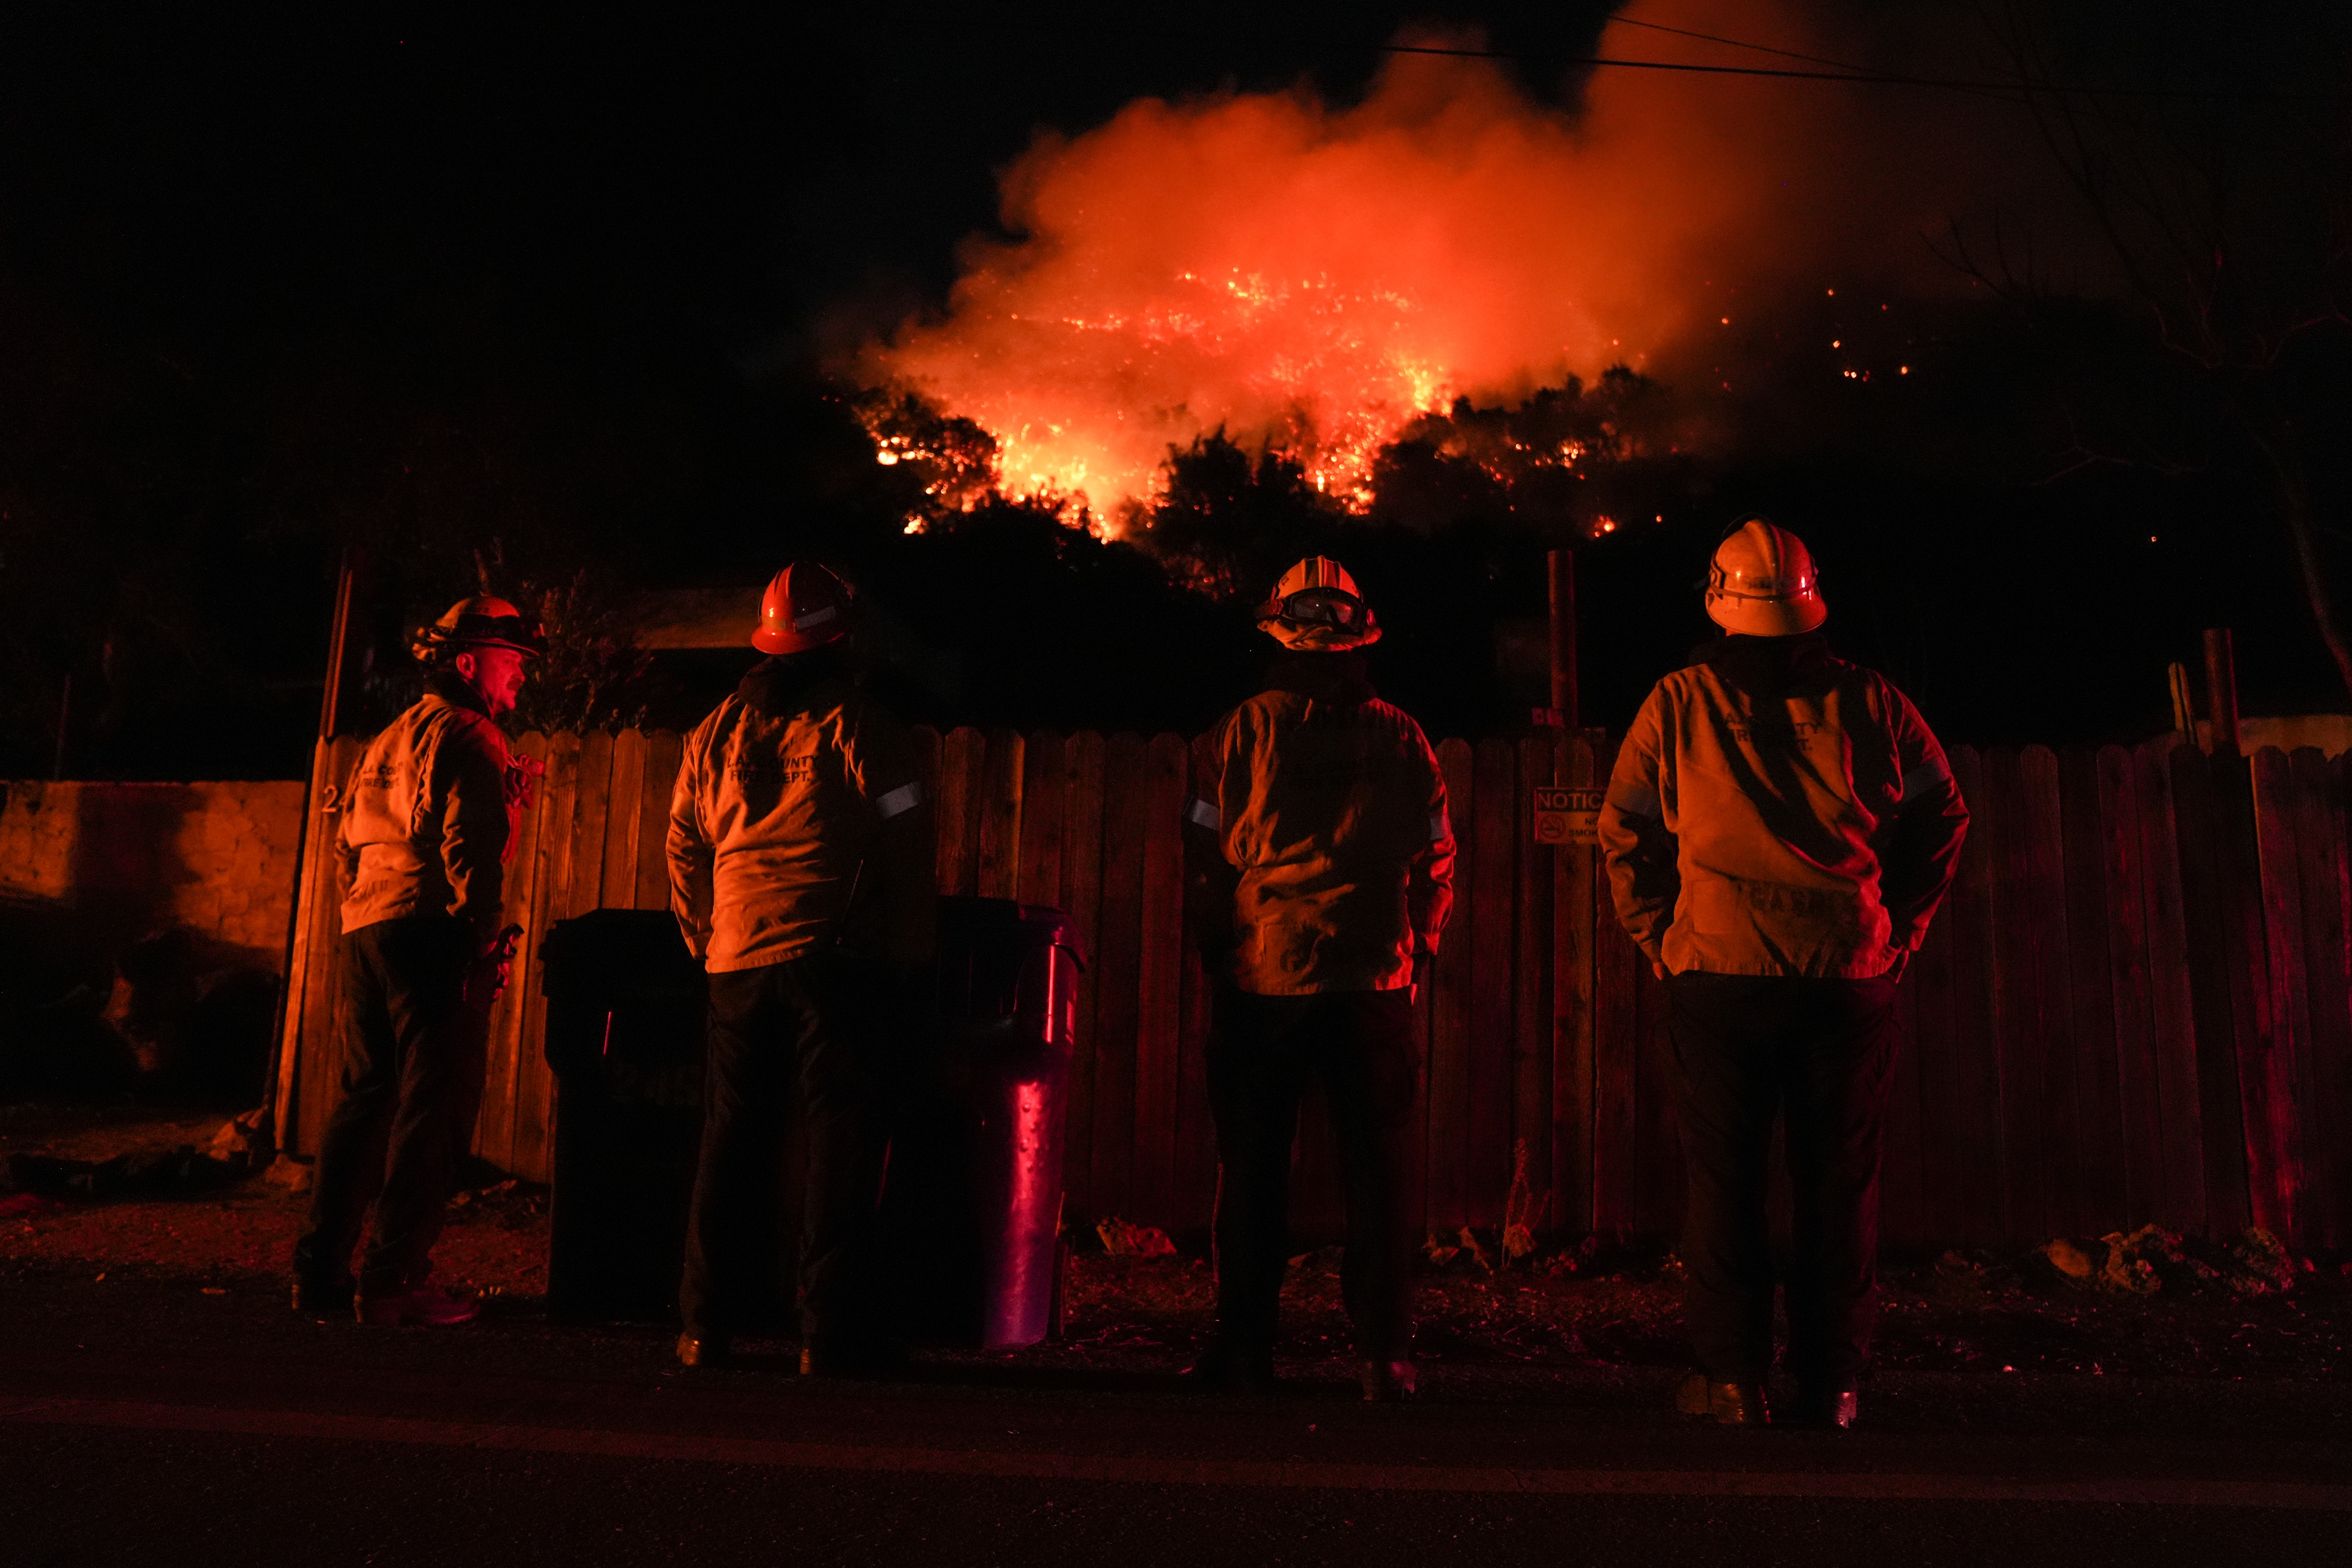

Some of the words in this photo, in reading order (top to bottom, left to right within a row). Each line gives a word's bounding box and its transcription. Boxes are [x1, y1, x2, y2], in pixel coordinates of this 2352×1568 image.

[321, 785, 338, 813] 2
[1538, 792, 1604, 809] NOTIC
[1568, 829, 1598, 837] SMOK
